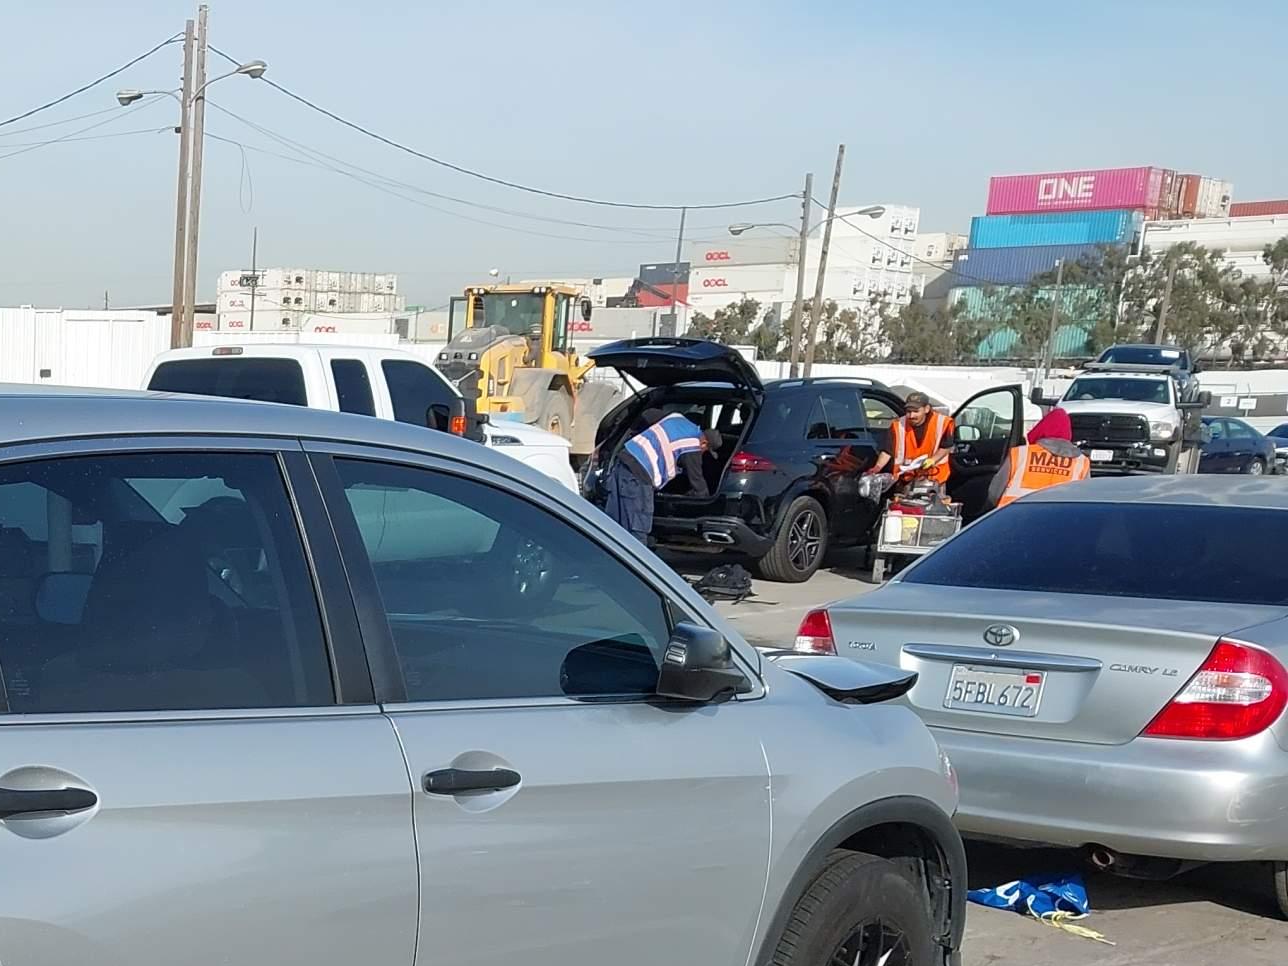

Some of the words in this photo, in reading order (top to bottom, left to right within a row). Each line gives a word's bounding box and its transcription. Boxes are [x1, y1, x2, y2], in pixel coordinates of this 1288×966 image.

[1038, 176, 1095, 200] ONE
[705, 252, 730, 261] OOCL
[703, 279, 728, 288] OOCL
[1030, 451, 1073, 469] MAD
[1109, 663, 1160, 675] CAMRY
[952, 680, 1035, 709] 5FBL672
